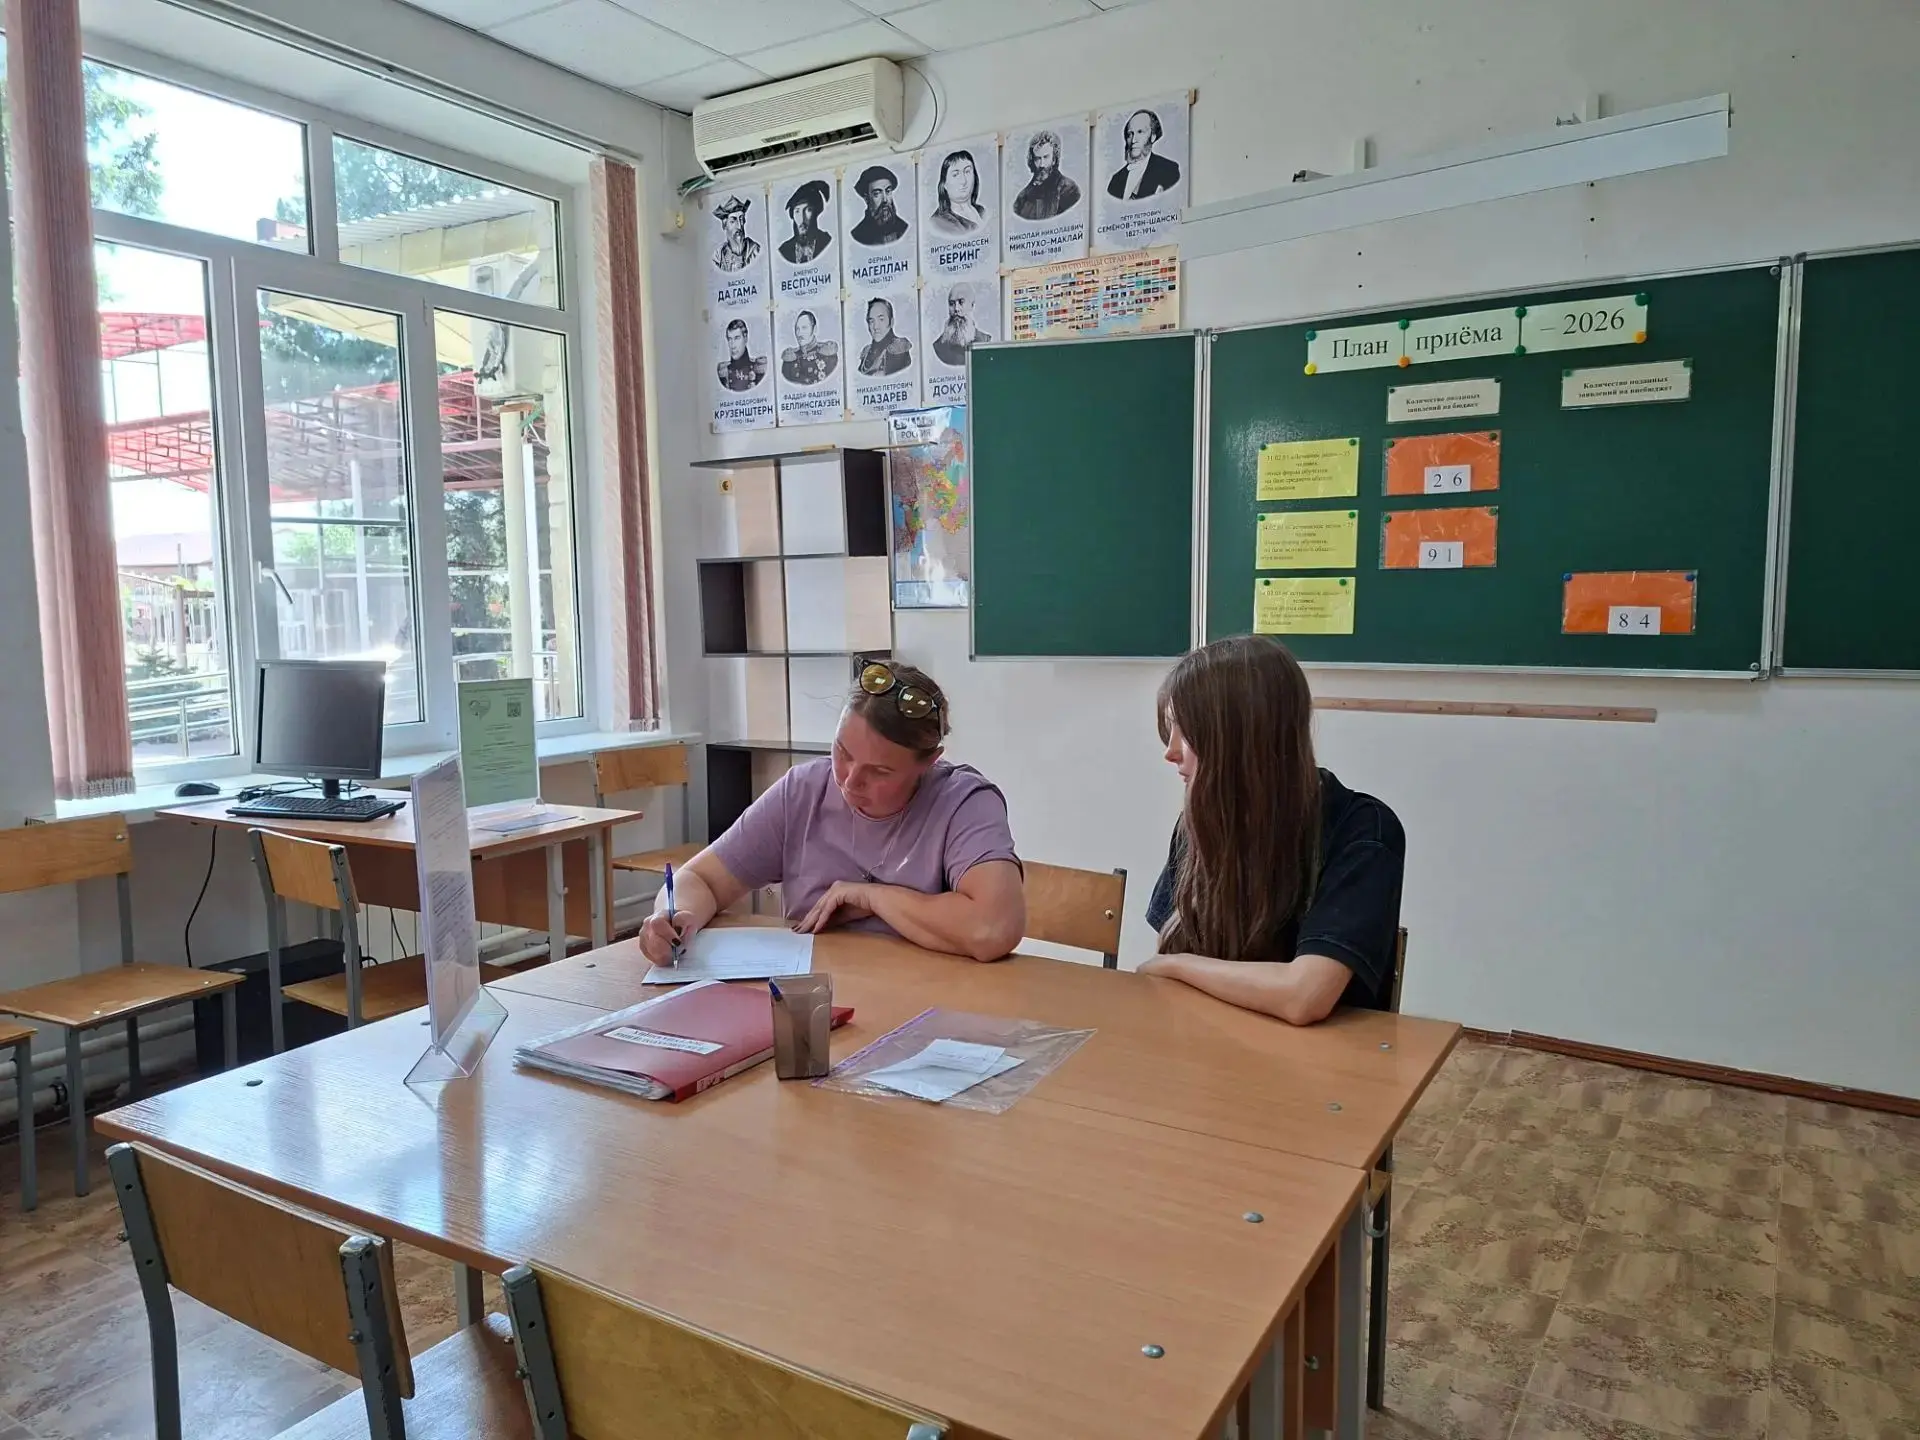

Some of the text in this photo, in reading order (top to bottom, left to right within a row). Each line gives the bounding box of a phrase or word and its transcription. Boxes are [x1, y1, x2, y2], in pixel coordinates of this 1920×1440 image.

[1126, 226, 1156, 238] 1827-1914
[952, 238, 989, 250] ИОНАССЕН
[1009, 231, 1084, 252] МИКЛУХО-МАКЛАЙ
[939, 248, 980, 265] БЕРИНГ
[852, 260, 908, 279] МАГЕЛЛАН
[781, 273, 831, 291] ВЕСПУЧЧИ
[718, 286, 758, 302] ДА ГАМА
[1332, 338, 1389, 359] План
[1416, 326, 1503, 354] приёма
[1562, 308, 1625, 335] 2026
[882, 382, 913, 391] ПЕТРОВИЧ
[1584, 380, 1628, 390] Количество
[780, 398, 840, 411] БЕЛЛИНСГАУЗЕН
[862, 390, 908, 406] ЛАЗАРЕВ
[1406, 396, 1444, 405] Количество
[714, 405, 774, 420] КРУЗЕНШТЕРН
